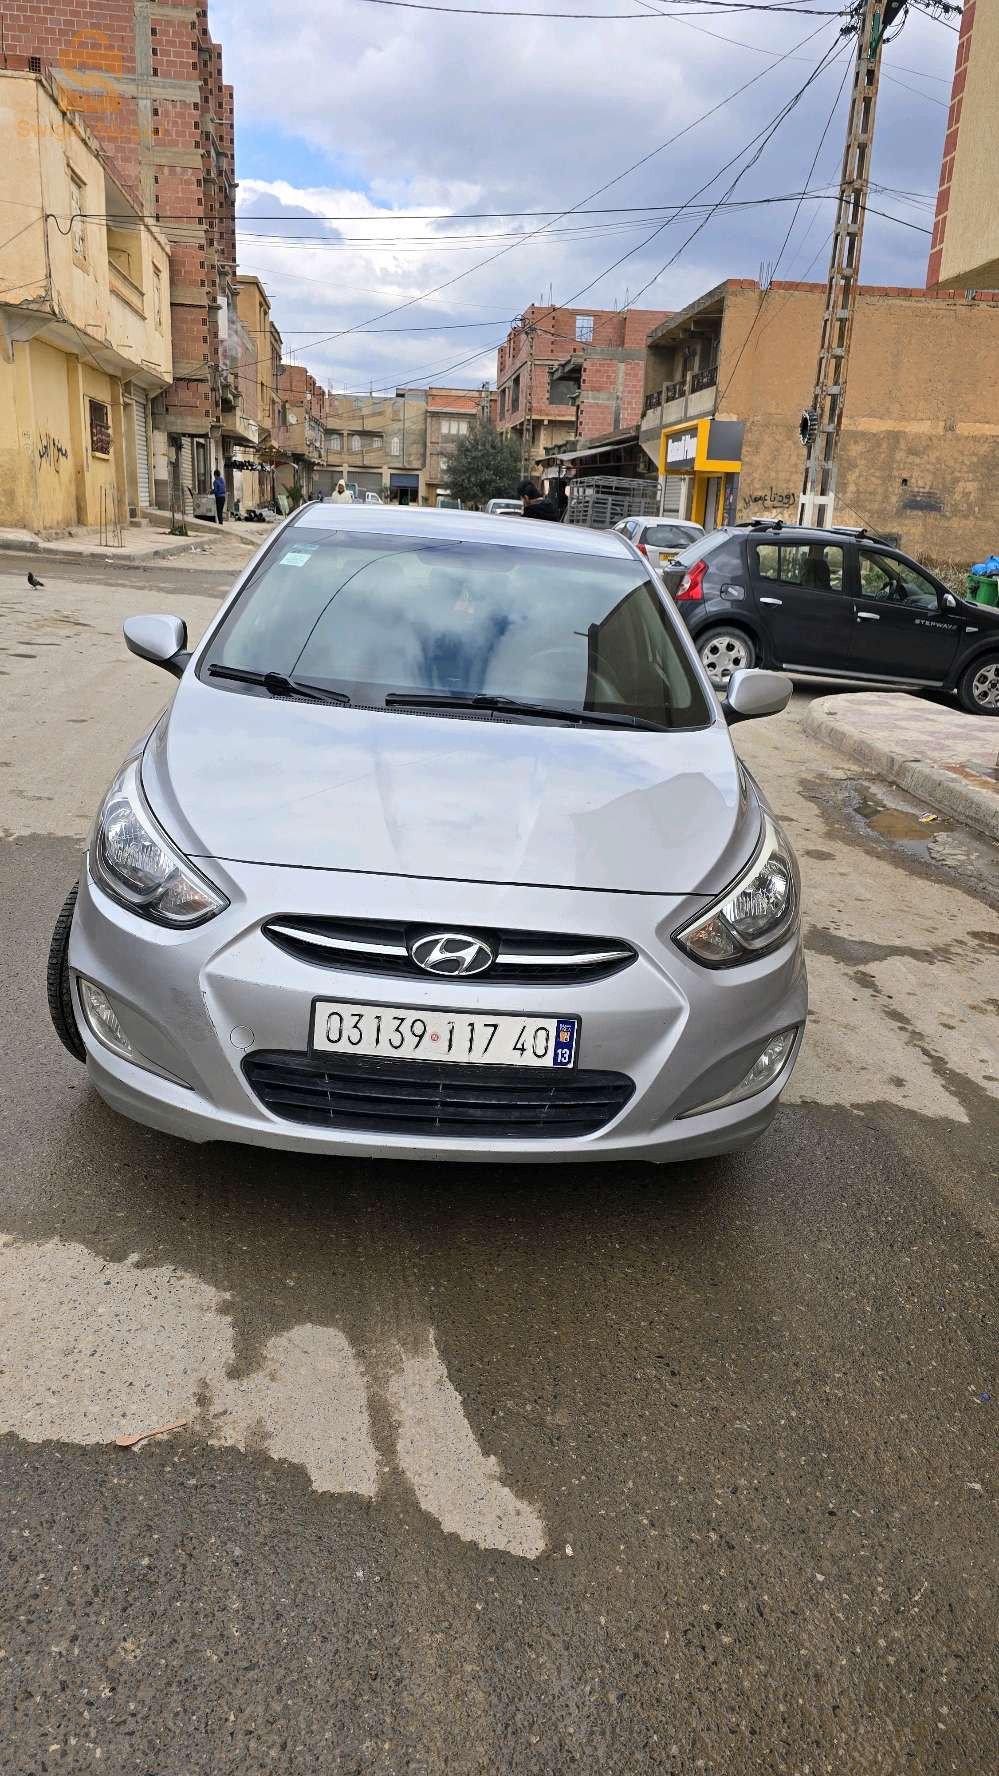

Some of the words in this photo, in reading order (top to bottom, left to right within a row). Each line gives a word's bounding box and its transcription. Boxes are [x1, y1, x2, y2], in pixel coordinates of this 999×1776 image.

[914, 619, 953, 630] STEPWAY
[326, 1011, 428, 1050] 03139
[446, 1021, 499, 1055] 117
[512, 1025, 550, 1059] 40
[556, 1048, 570, 1063] 13
